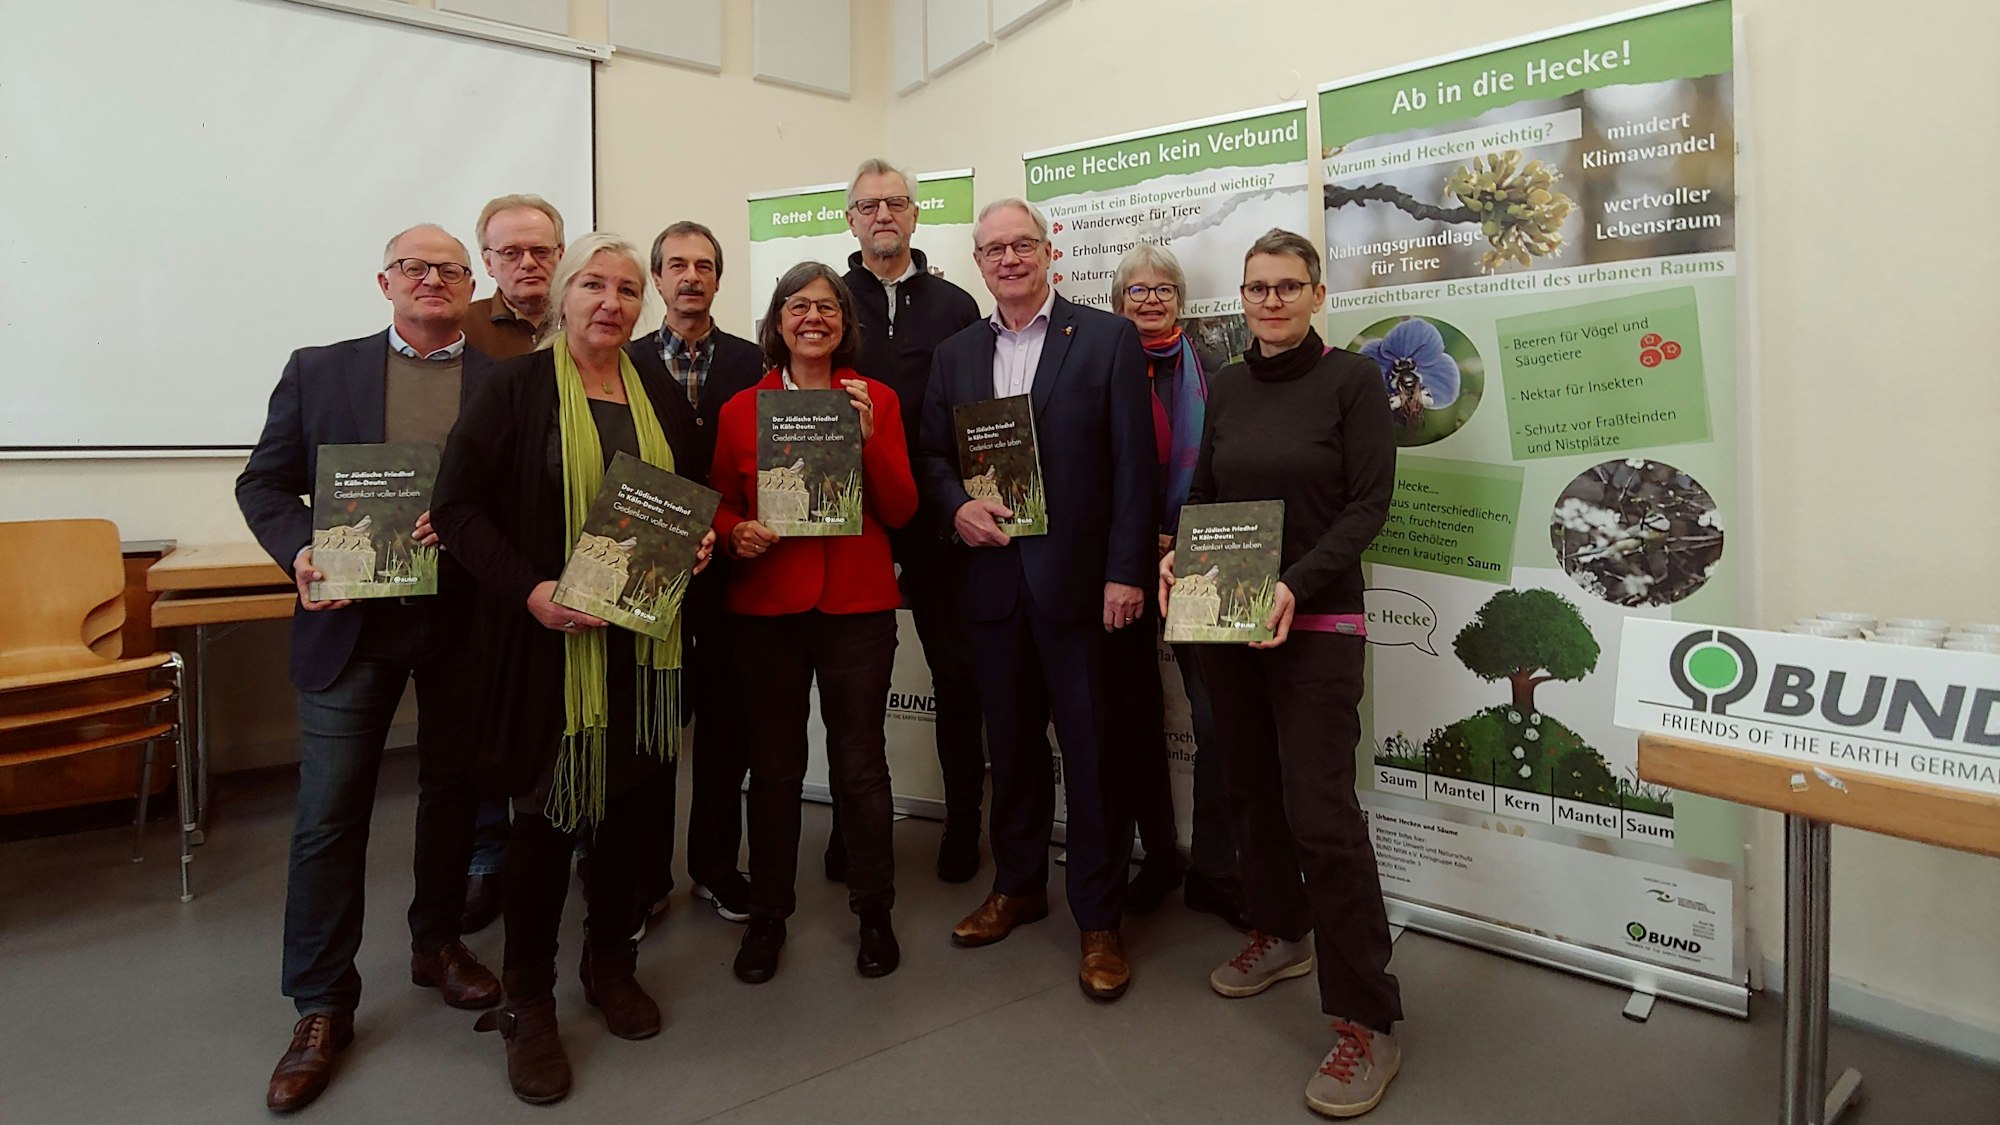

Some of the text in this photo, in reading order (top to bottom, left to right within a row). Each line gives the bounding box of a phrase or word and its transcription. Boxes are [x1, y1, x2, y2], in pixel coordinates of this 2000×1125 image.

[1392, 39, 1632, 115] Ab in die Hecke!
[1607, 112, 1690, 141] mindert
[1030, 120, 1299, 185] Ohne Hecken kein Verbund
[1327, 123, 1554, 178] Warum sind Hecken wichtig?
[1582, 134, 1715, 169] Klimawandel
[1050, 173, 1275, 218] Warum ist ein Biotopverbund wichtig?
[1604, 186, 1711, 214] wertvoller
[772, 209, 813, 226] Rettet
[816, 206, 844, 221] den
[1071, 204, 1201, 231] Wanderwege für Tiere
[1596, 212, 1721, 240] Lebensraum
[1329, 228, 1483, 261] Nahrungsgrundlage
[1071, 269, 1115, 282] Naturra
[1370, 255, 1440, 276] für Tiere
[1331, 258, 1724, 309] Unverzichtbarer Bestandteil des urbanen Raums
[1191, 303, 1209, 314] der
[1512, 318, 1649, 351] Beeren für Vögel und
[1515, 349, 1582, 368] Säugetiere
[1520, 375, 1643, 401] Nektar für Insekten
[785, 415, 812, 423] Jüdische
[1524, 409, 1676, 437] Schutz vor Fraßfeinden
[772, 433, 807, 442] Gedenkort
[825, 433, 845, 441] Leben
[1527, 434, 1620, 454] und Nistplätze
[344, 479, 388, 487] Köln-Deutz:
[350, 471, 383, 479] Jüdische
[384, 470, 416, 478] Friedhof
[334, 489, 421, 499] Gedenkort voller Leben
[617, 491, 665, 514] in Köln-Deutz:
[621, 483, 692, 517] Der Jüdische Friedhof
[613, 501, 689, 537] Gedenkort voller Leben
[1391, 498, 1512, 524] aus unterschiedlichen,
[1204, 526, 1230, 534] Jüdische
[1231, 524, 1258, 532] Friedhof
[1409, 516, 1474, 534] fruchtenden
[1190, 543, 1223, 552] Gedenkort
[1242, 541, 1262, 549] Leben
[1198, 533, 1234, 541] Köln-Deutz:
[1409, 531, 1458, 548] Gehölzen
[1382, 543, 1410, 556] einen
[1414, 548, 1464, 565] krautigen
[1467, 556, 1501, 571] Saum
[1382, 609, 1431, 627] Hecke
[889, 693, 936, 711] BUND
[1763, 663, 2000, 748] BUND
[1661, 713, 2000, 785] FRIENDS OF THE EARTH GERMA
[1380, 771, 1675, 839] Saum Mantel Kern Mantel Saum
[1376, 813, 1458, 836] Urbane Hecken und Säume
[1376, 827, 1397, 837] Weitere
[1649, 931, 1701, 953] BUND
